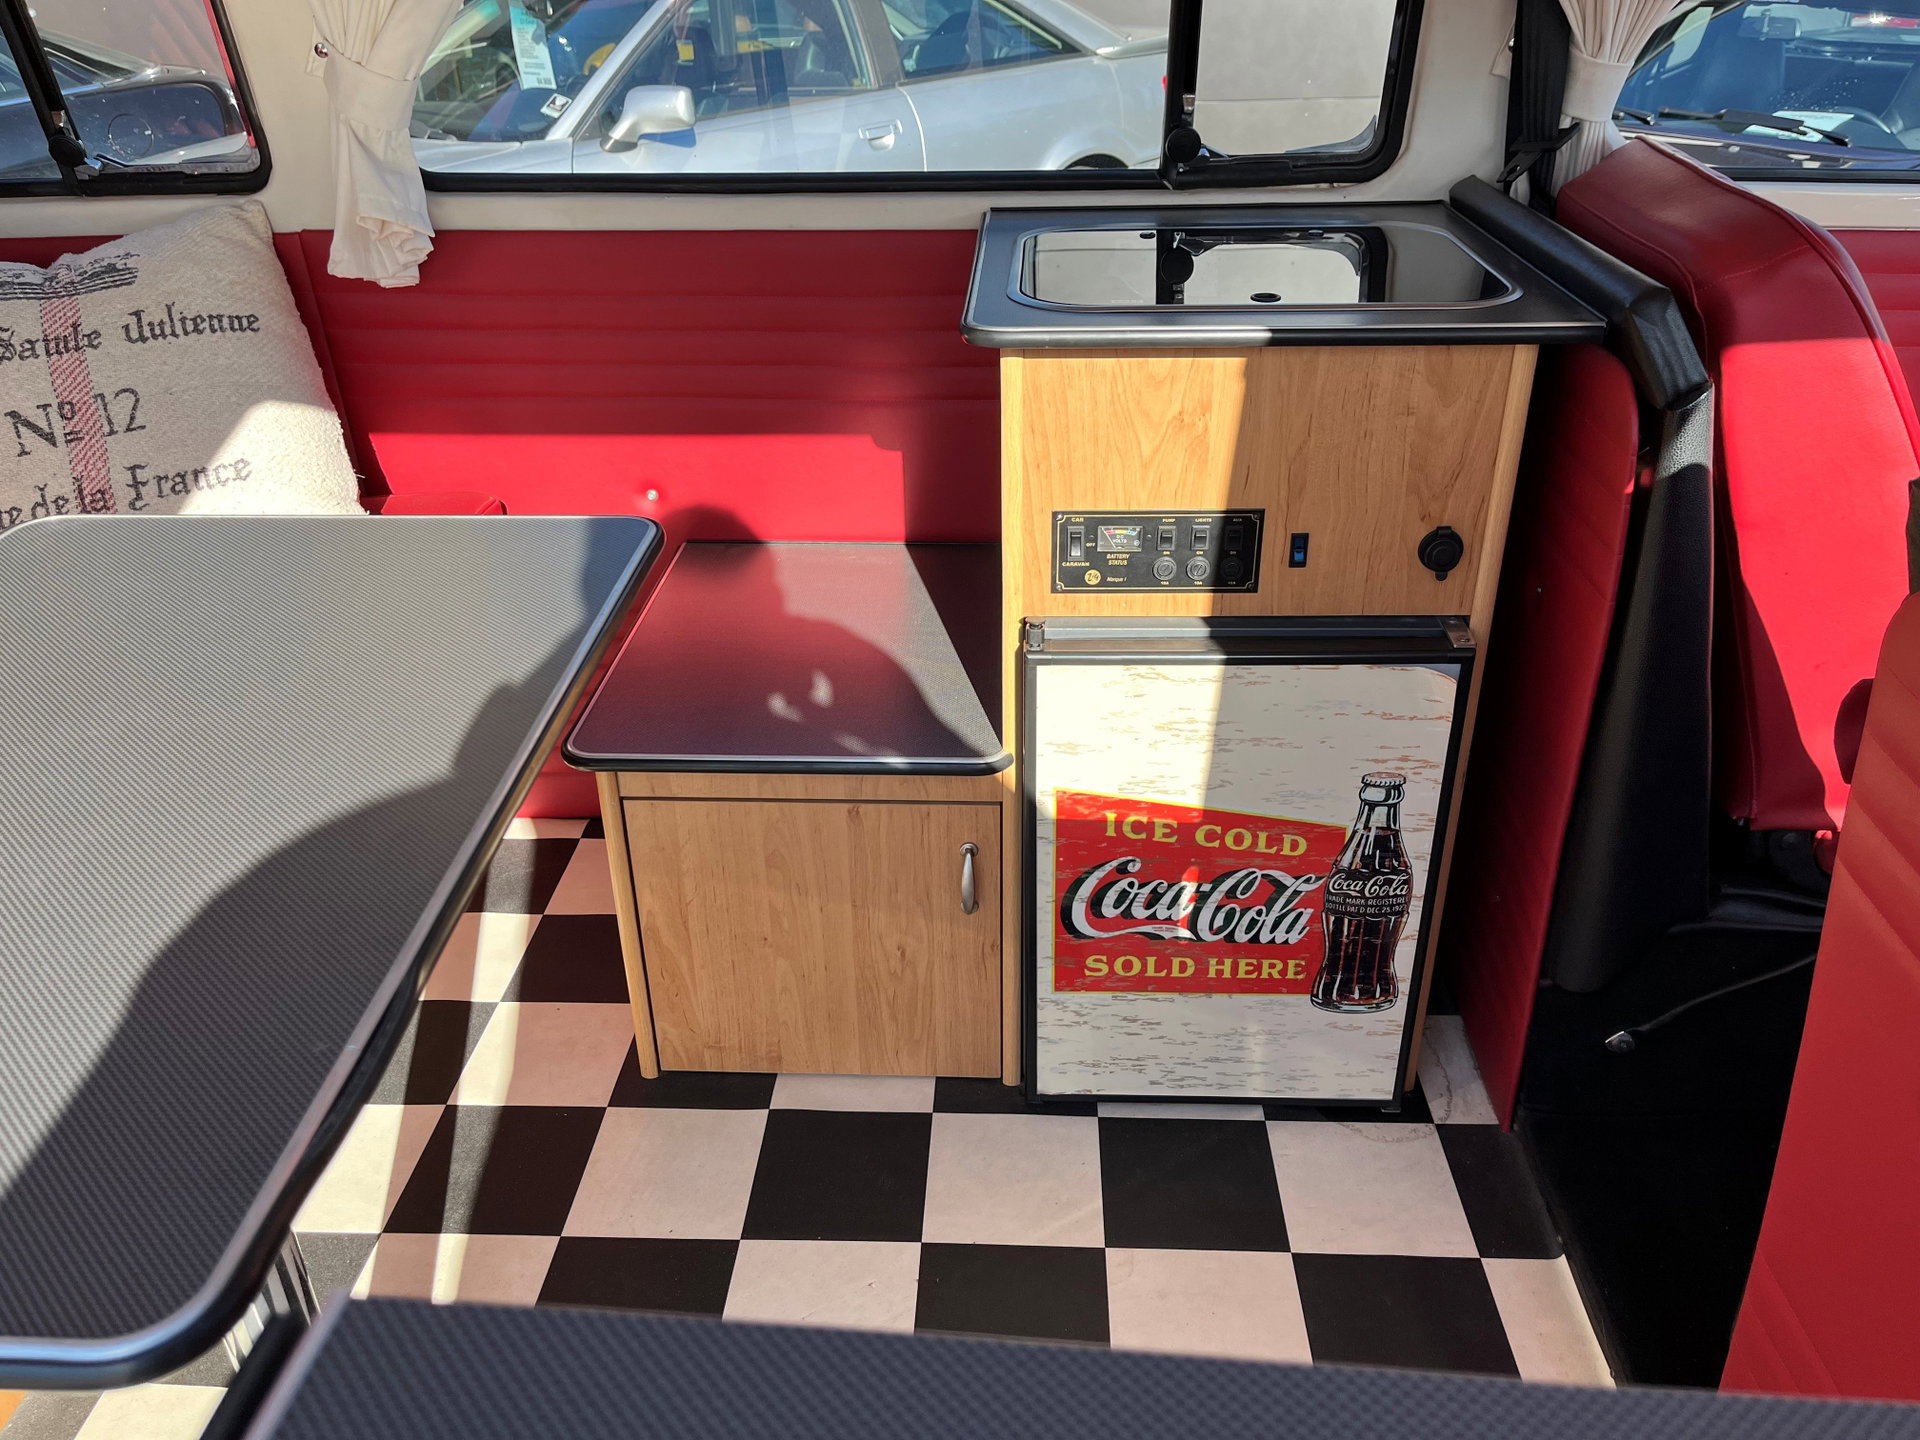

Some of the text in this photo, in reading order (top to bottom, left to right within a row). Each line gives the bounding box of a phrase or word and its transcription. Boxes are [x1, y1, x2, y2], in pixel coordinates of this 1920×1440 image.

[95, 387, 147, 437] 12
[123, 457, 252, 511] France
[1105, 812, 1308, 857] ICE COLD
[1066, 855, 1327, 946] Coca-Cola
[1345, 897, 1366, 906] MARK
[1083, 954, 1308, 980] SOLD HERE
